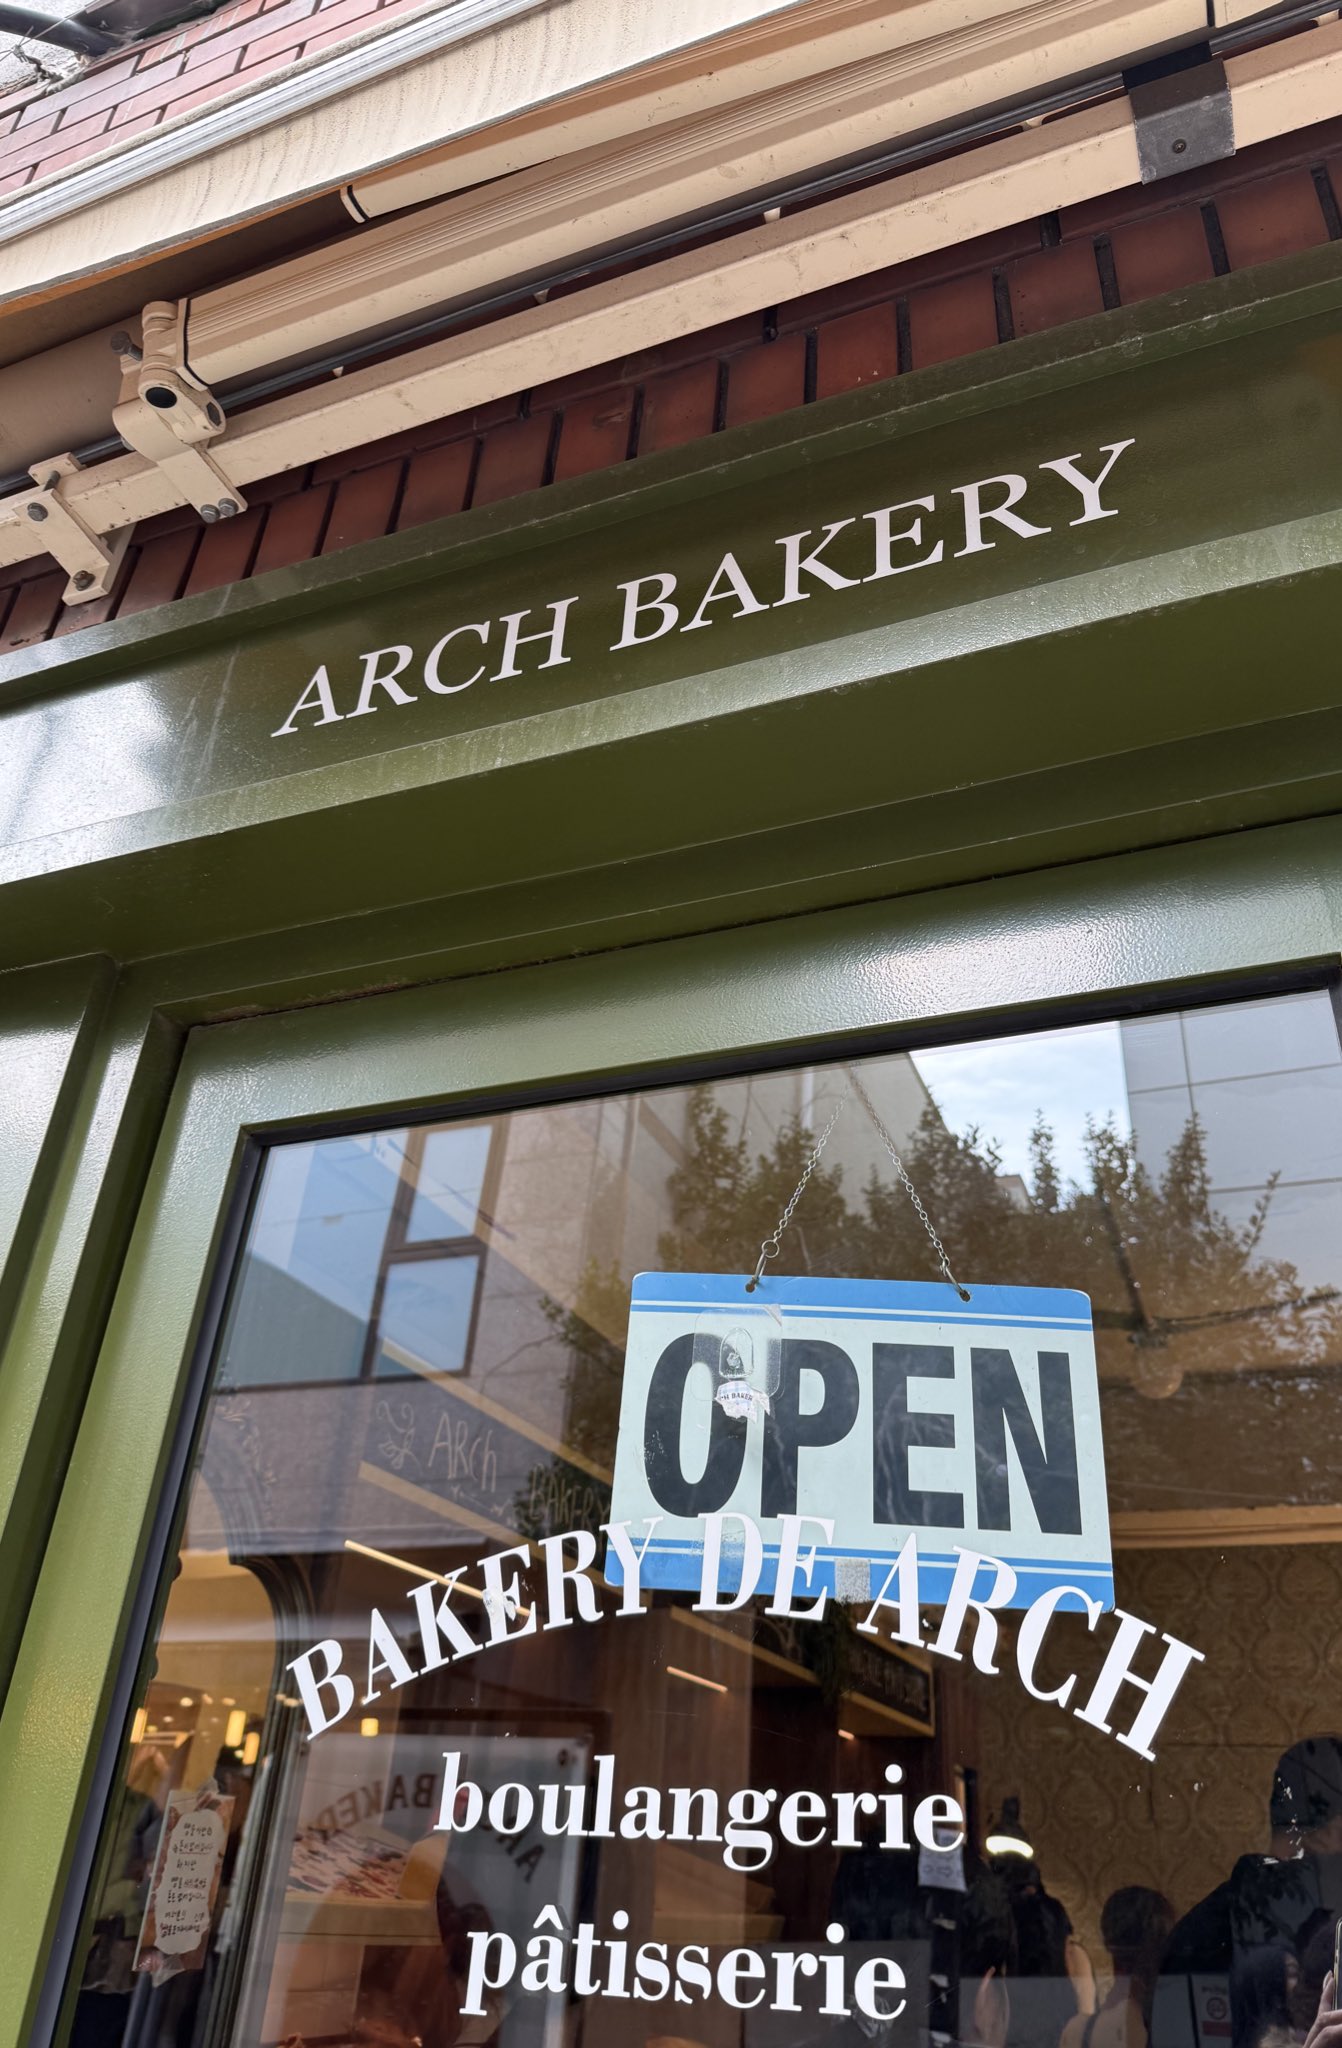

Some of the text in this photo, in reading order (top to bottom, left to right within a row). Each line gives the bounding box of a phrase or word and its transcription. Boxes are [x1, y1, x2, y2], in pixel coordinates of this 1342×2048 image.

[271, 438, 1135, 738] ARCH BAKERY
[644, 1333, 1083, 1536] OPEN
[285, 1512, 1205, 1762] BAKERY DE ARCH
[433, 1752, 966, 1873] boulangerie
[459, 1904, 907, 2020] pâtisserie
